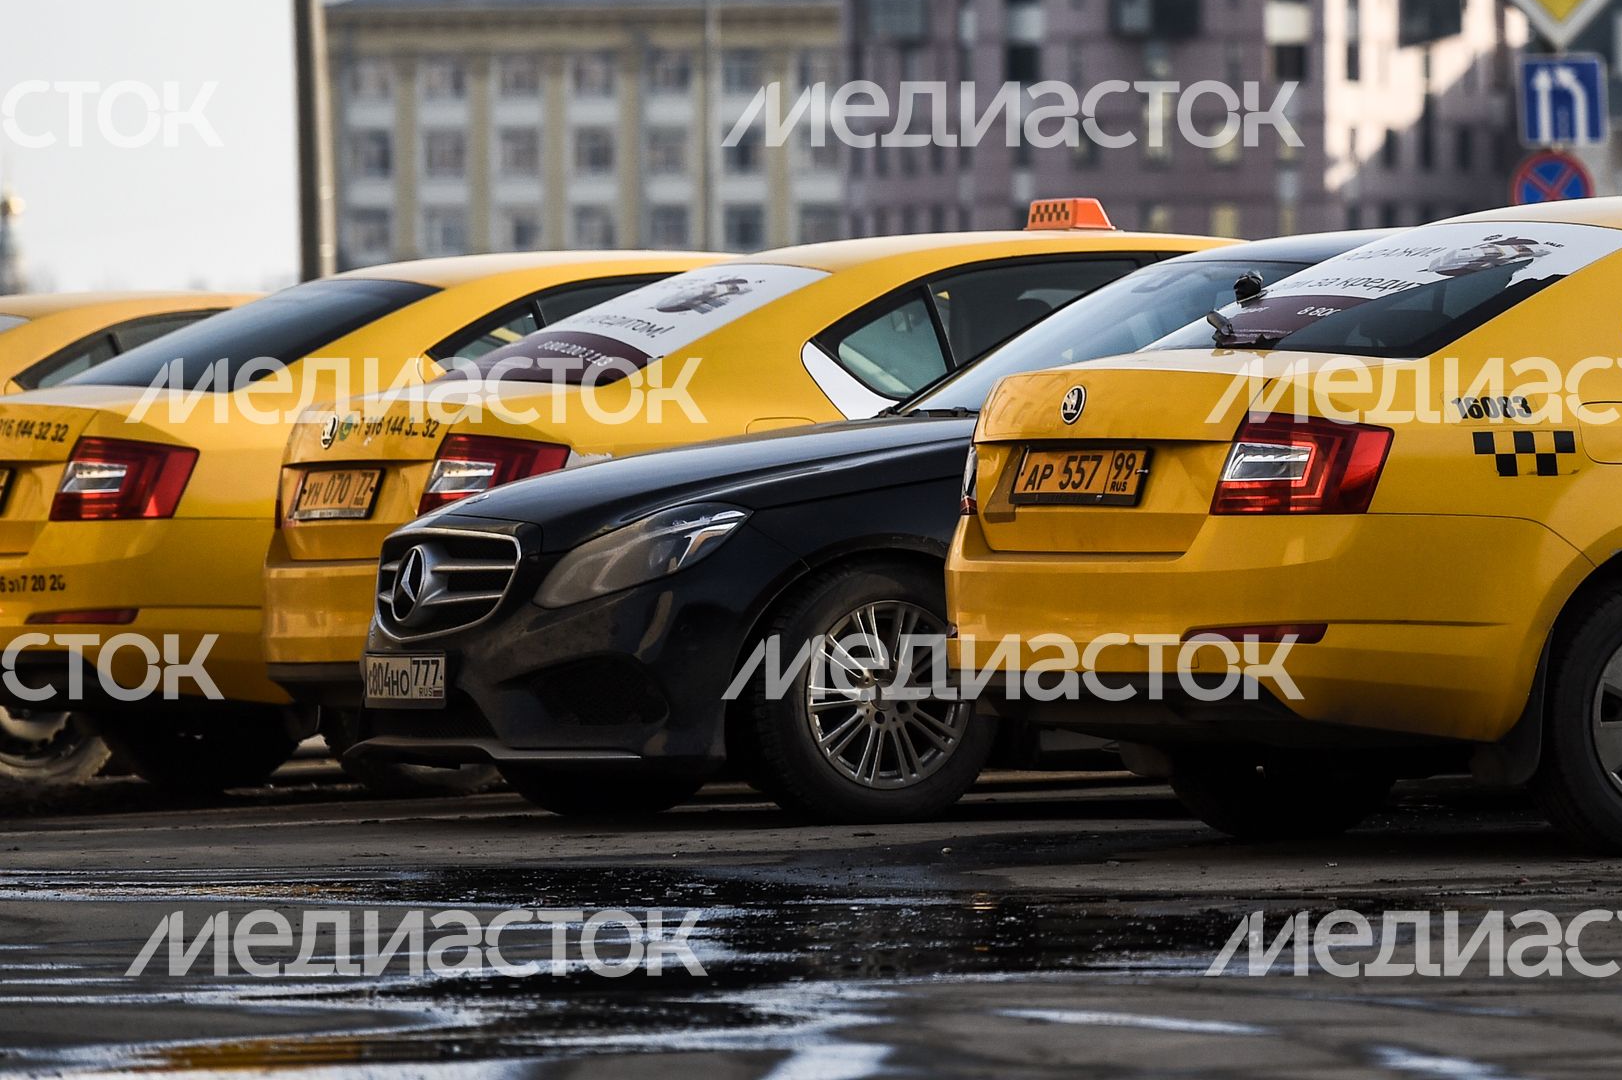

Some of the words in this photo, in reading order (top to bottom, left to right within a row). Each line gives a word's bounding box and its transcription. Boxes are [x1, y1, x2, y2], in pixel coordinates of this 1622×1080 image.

[1451, 395, 1532, 419] 16083
[34, 421, 52, 440] 32
[51, 423, 69, 442] 32
[385, 416, 406, 435] 144
[422, 418, 440, 438] 32
[1023, 464, 1054, 491] АР
[1058, 455, 1103, 490] 557
[1112, 452, 1137, 481] 99
[322, 472, 353, 504] 070
[356, 472, 375, 496] 77
[1110, 481, 1128, 492] RUS
[31, 575, 46, 592] 20
[412, 659, 440, 687] 777
[418, 686, 433, 697] RUS
